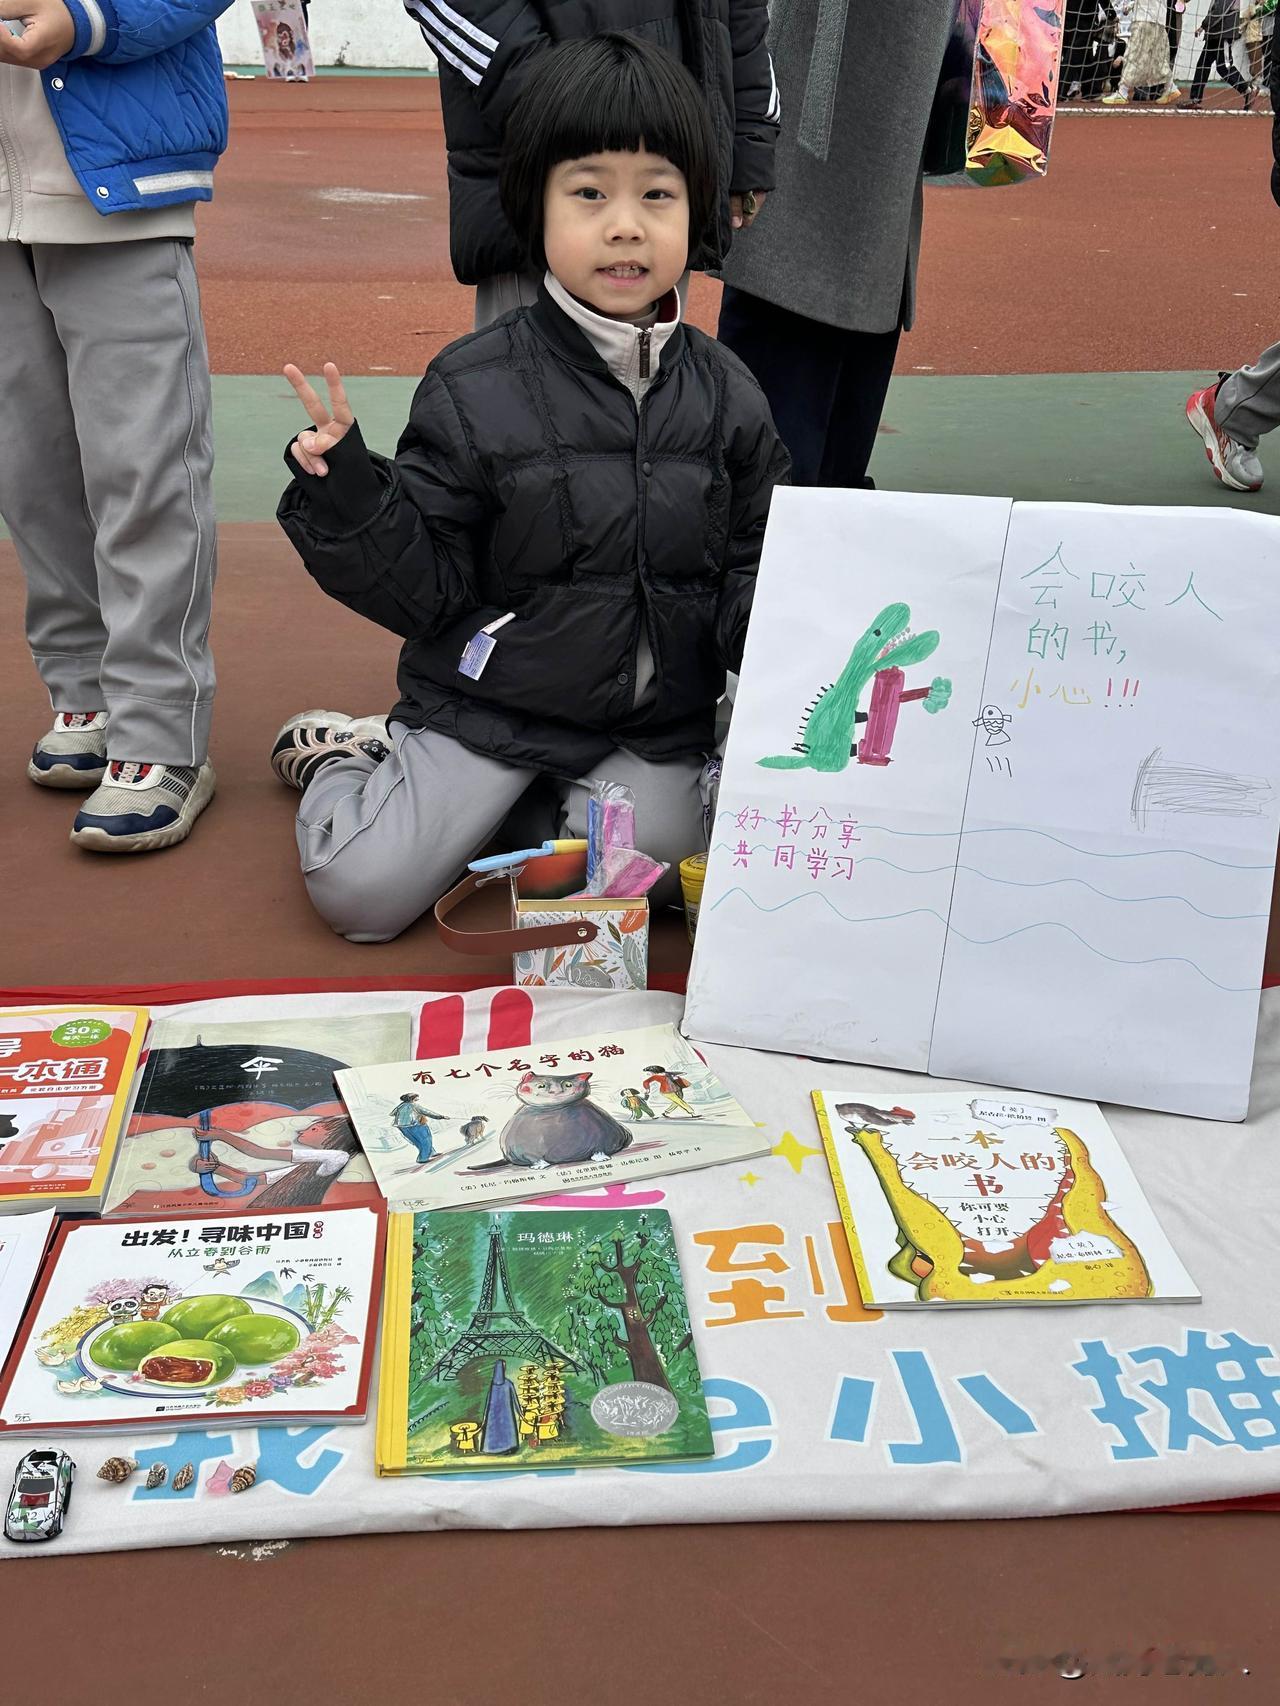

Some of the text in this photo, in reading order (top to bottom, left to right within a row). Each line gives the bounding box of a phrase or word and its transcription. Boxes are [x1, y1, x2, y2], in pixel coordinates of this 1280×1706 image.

[1020, 541, 1224, 622] 会咬人
[735, 804, 861, 849] 好书分享
[732, 840, 854, 881] 共同学习
[240, 1056, 284, 1081] 伞
[412, 1044, 626, 1087] 有七个名字的猫
[928, 1130, 1005, 1149] 一本
[906, 1152, 1057, 1172] 会咬人的
[964, 1174, 1005, 1197] 书
[959, 1201, 1010, 1213] 你可要
[973, 1213, 1006, 1225] 小心
[517, 1231, 574, 1243] 玛德琳
[976, 1226, 1010, 1237] 打开
[168, 1245, 272, 1258] 从立春到谷雨
[693, 1222, 885, 1328] 到
